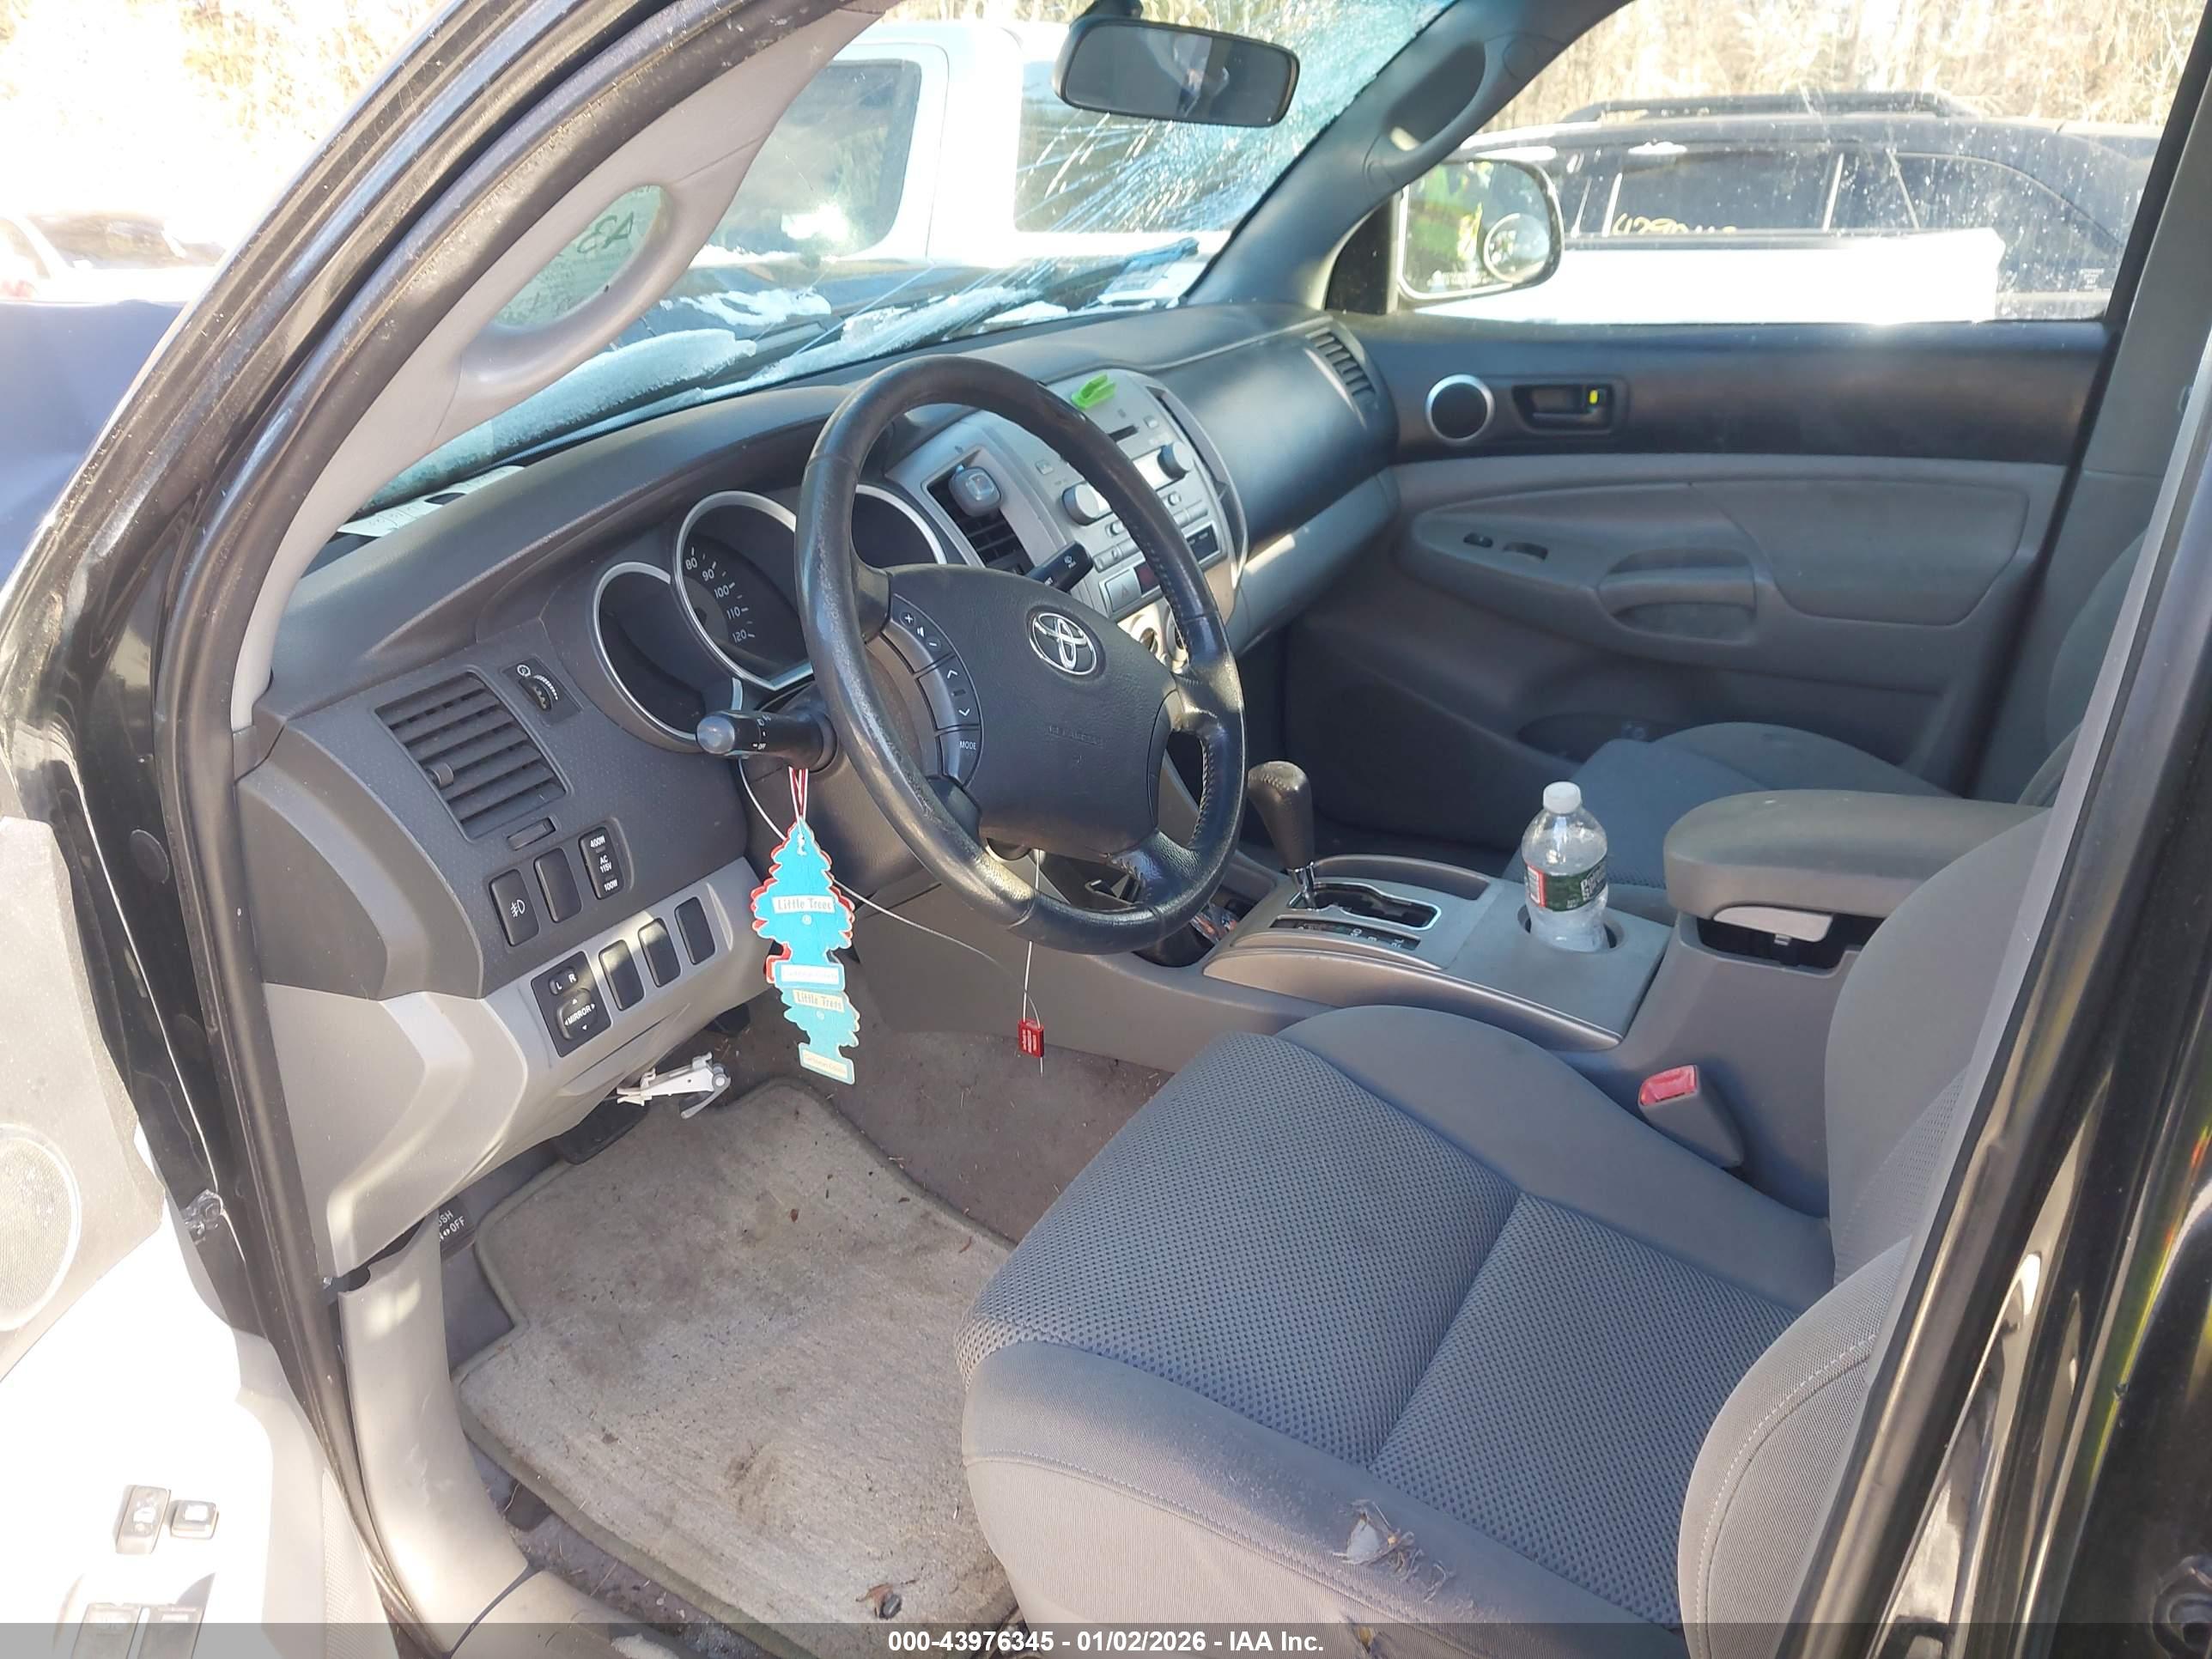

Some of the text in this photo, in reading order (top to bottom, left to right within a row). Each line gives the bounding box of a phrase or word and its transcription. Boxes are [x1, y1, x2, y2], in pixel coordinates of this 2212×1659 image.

[685, 557, 697, 570] 80
[702, 568, 714, 581] 90
[714, 585, 730, 599] 100
[726, 606, 741, 619] 110
[732, 629, 747, 643] 120
[959, 740, 976, 750] MODE
[590, 835, 605, 848] 400W
[600, 854, 608, 865] AC
[599, 861, 612, 873] 115V
[604, 878, 618, 892] 100W
[777, 897, 832, 910] Little Trees
[568, 973, 577, 983] R
[556, 981, 562, 990] L
[795, 991, 818, 1005] Little
[567, 1005, 592, 1025] MIRROR
[449, 1215, 465, 1232] OFF
